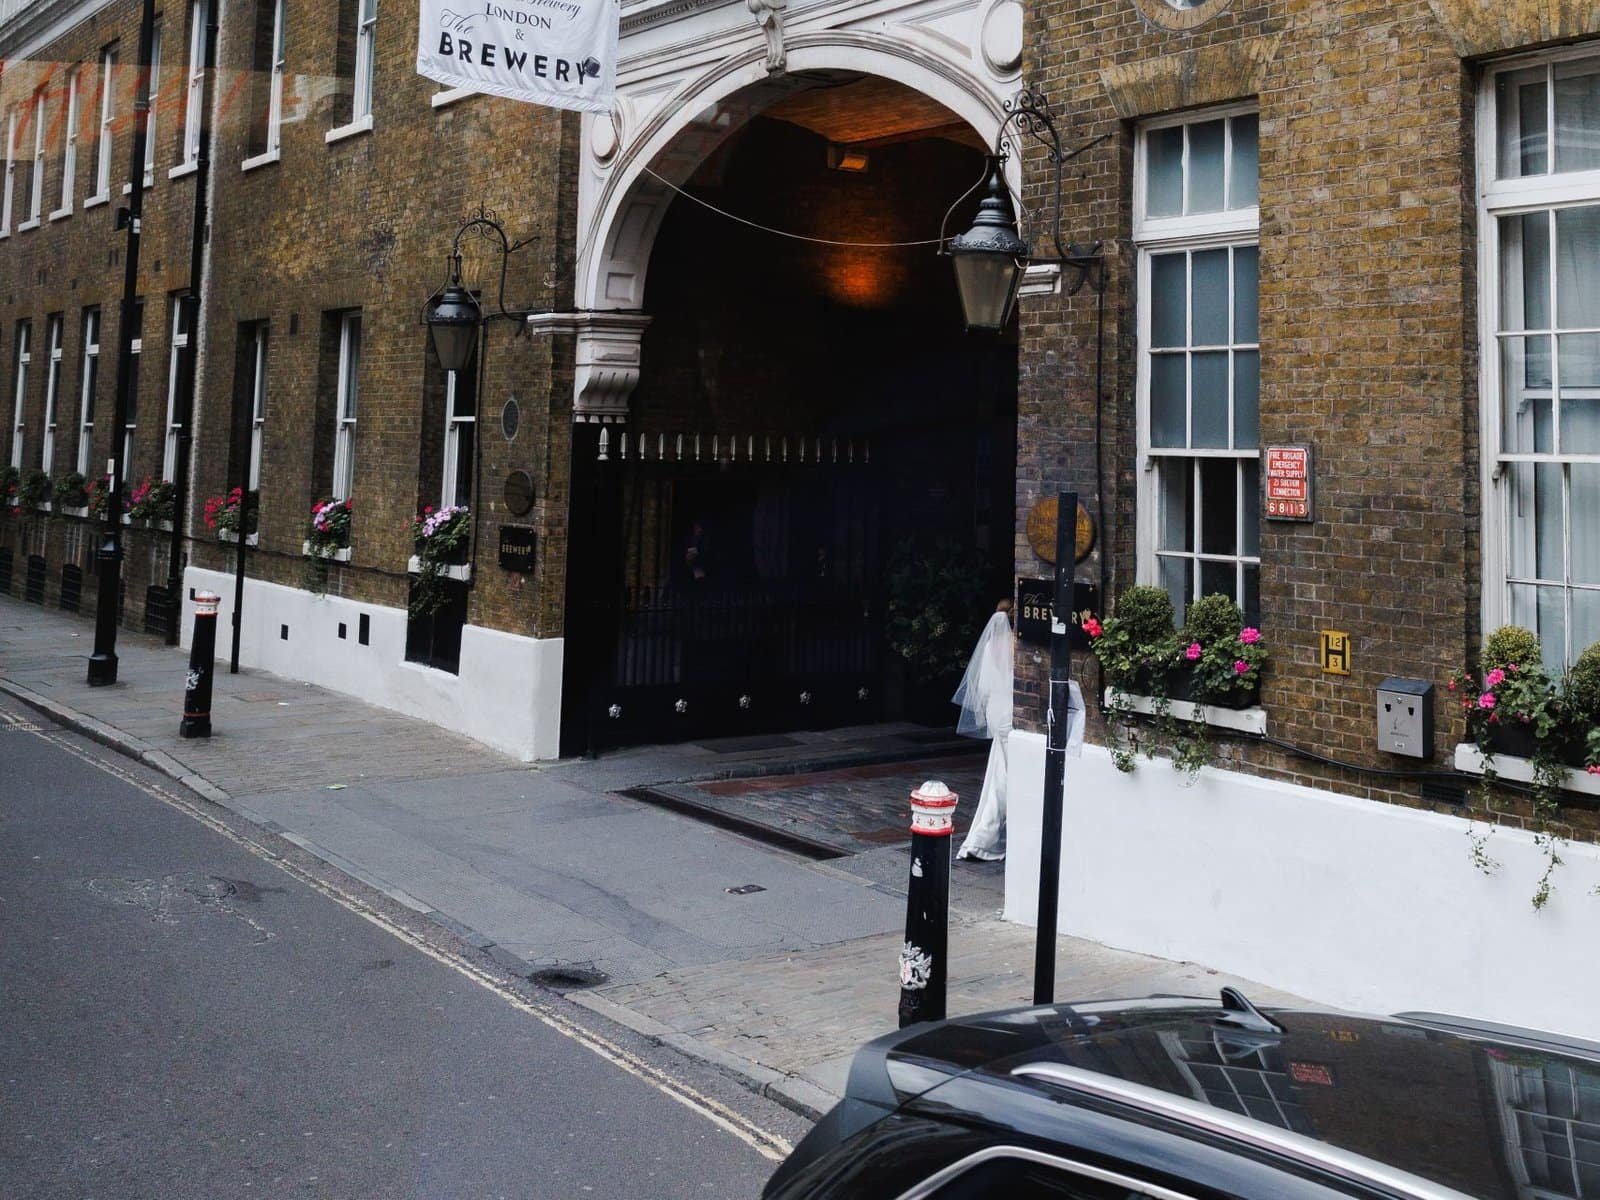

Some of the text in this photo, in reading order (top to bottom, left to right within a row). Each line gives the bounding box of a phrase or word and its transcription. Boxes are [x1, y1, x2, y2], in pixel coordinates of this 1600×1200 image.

[440, 8, 488, 35] The
[486, 3, 551, 29] LONDON
[515, 29, 525, 40] &
[439, 31, 587, 84] BREWERY
[1286, 470, 1304, 478] SUPPLY
[1269, 502, 1305, 514] 6813
[1024, 606, 1087, 625] BRERY
[1331, 637, 1341, 647] 12
[1325, 635, 1346, 670] H
[1332, 657, 1339, 667] 3
